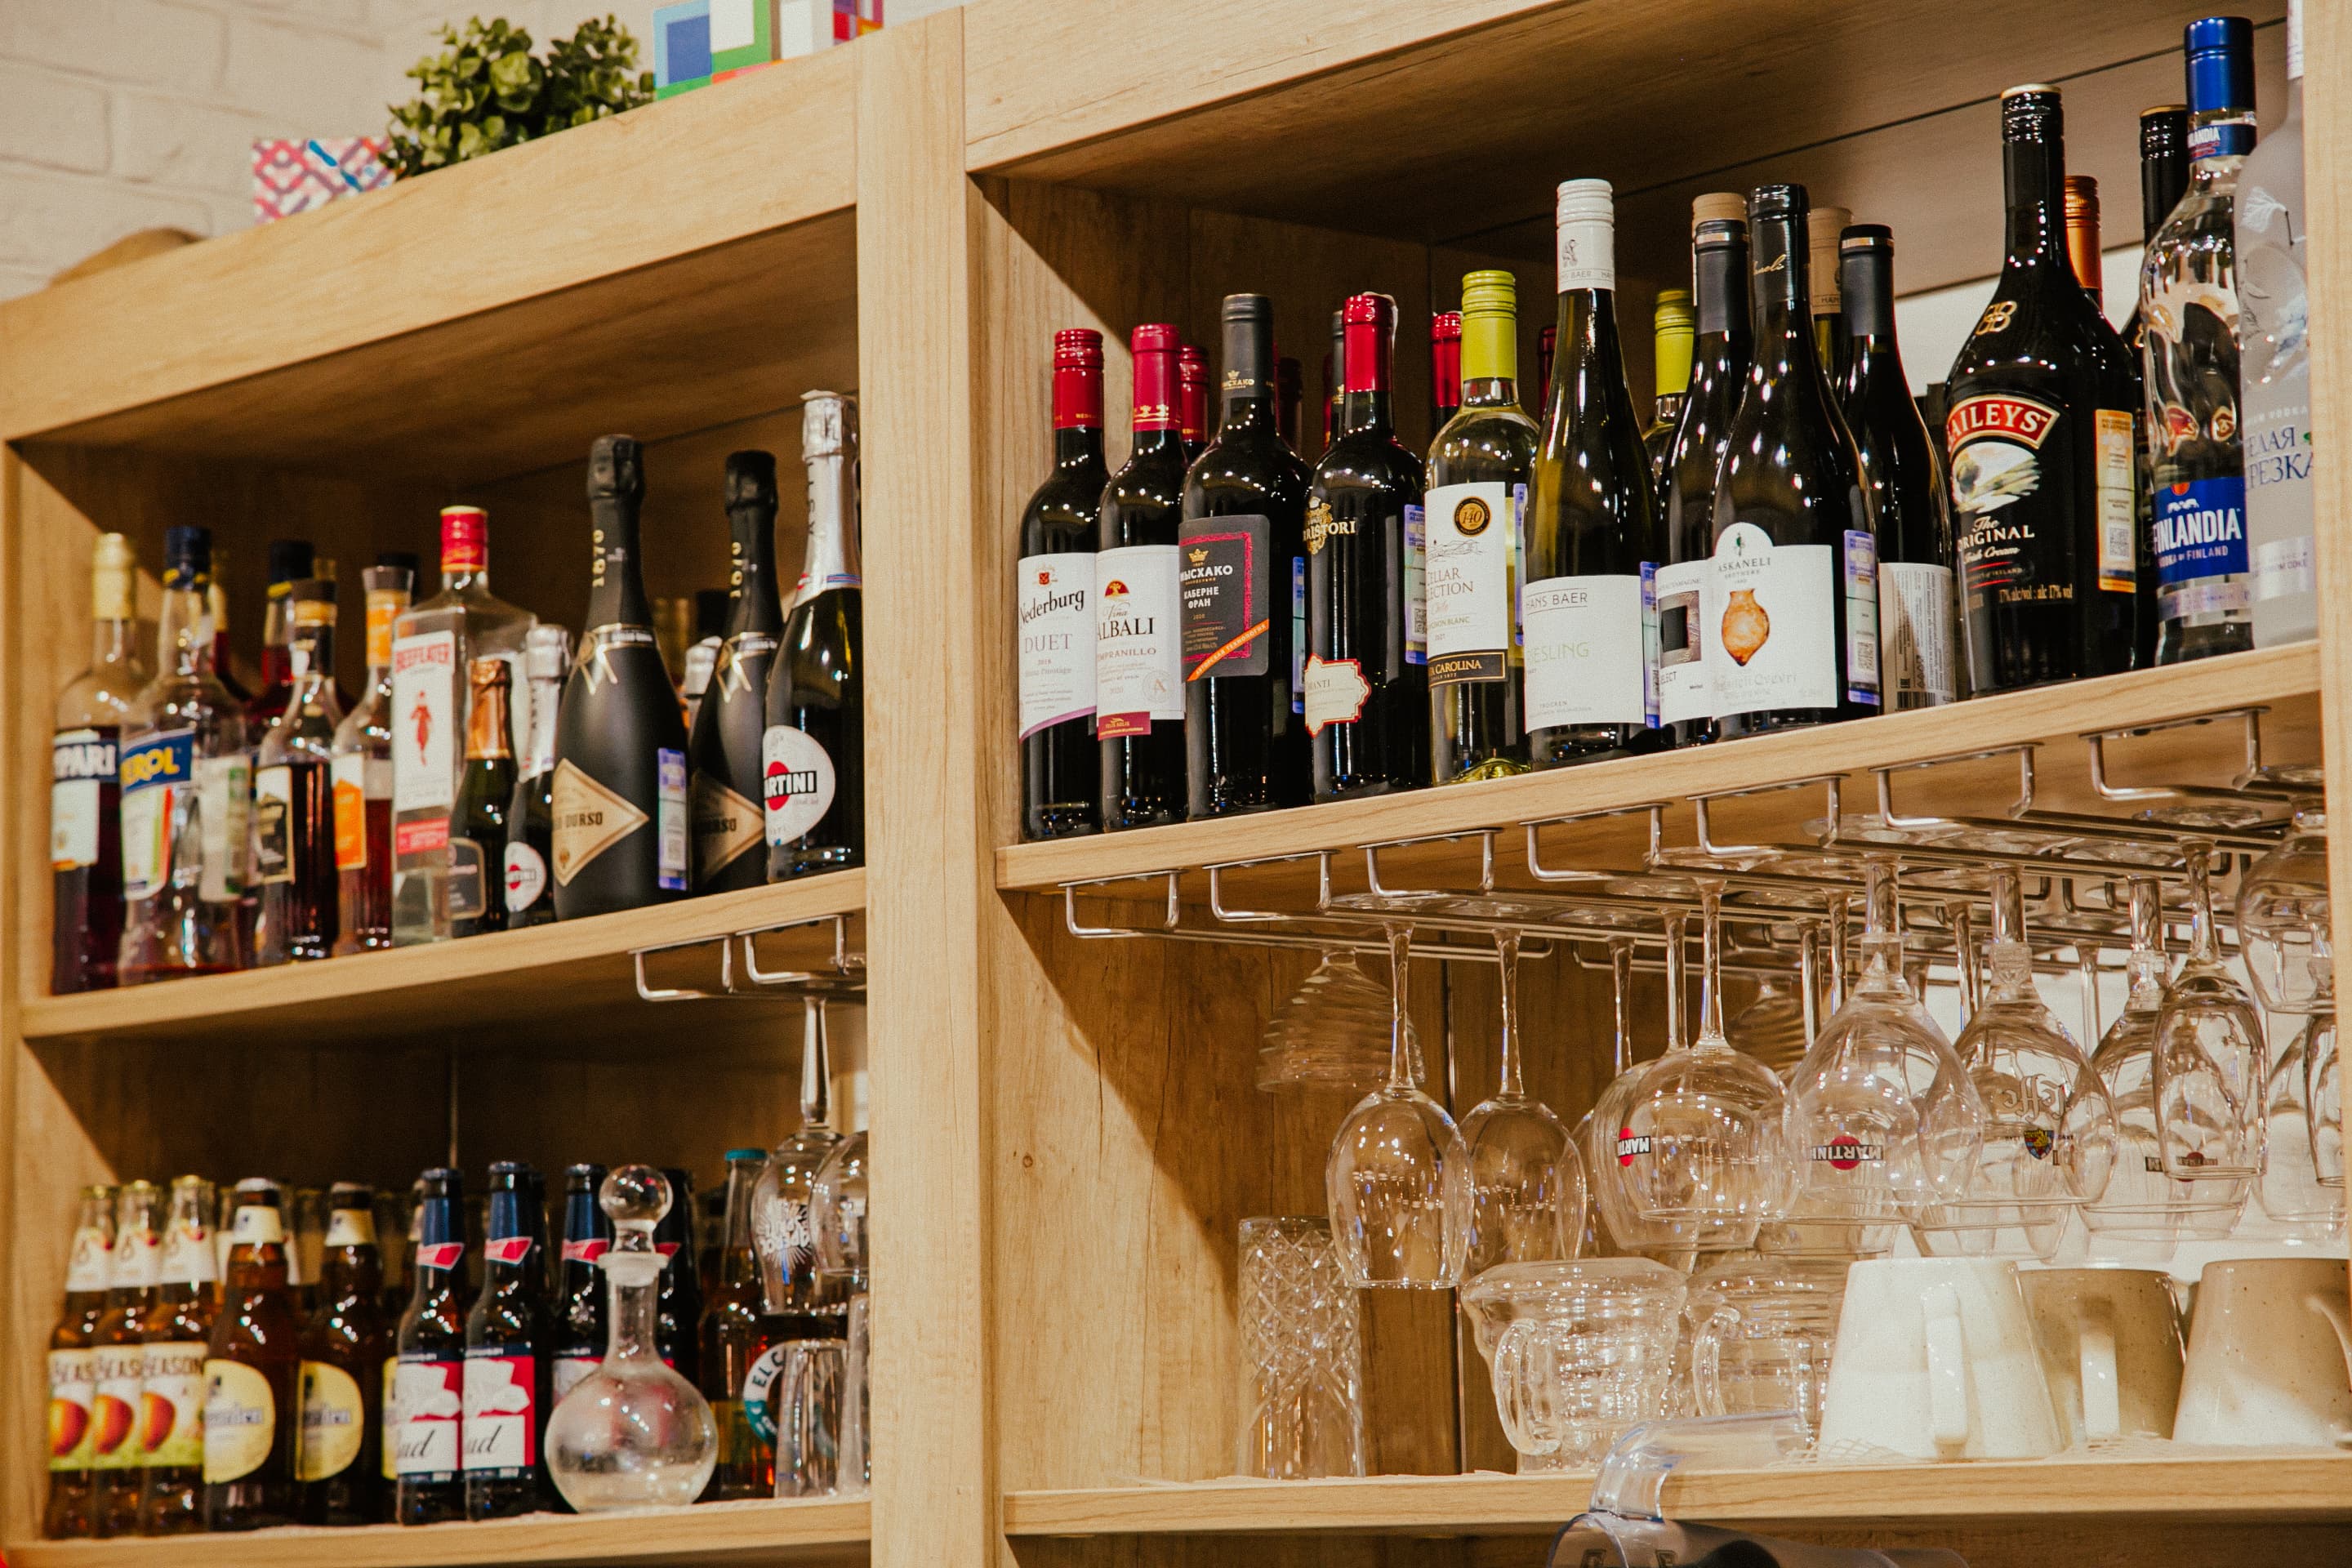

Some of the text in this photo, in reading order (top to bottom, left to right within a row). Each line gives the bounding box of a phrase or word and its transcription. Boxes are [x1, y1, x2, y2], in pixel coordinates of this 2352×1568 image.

[2153, 507, 2243, 555] FINLANDIA
[2186, 546, 2229, 561] FINLAND
[1552, 592, 1588, 606] BAER
[1025, 633, 1074, 654] DUET
[1435, 659, 1483, 675] CAROLINA
[121, 746, 180, 786] EROL
[764, 772, 815, 799] ARTINI
